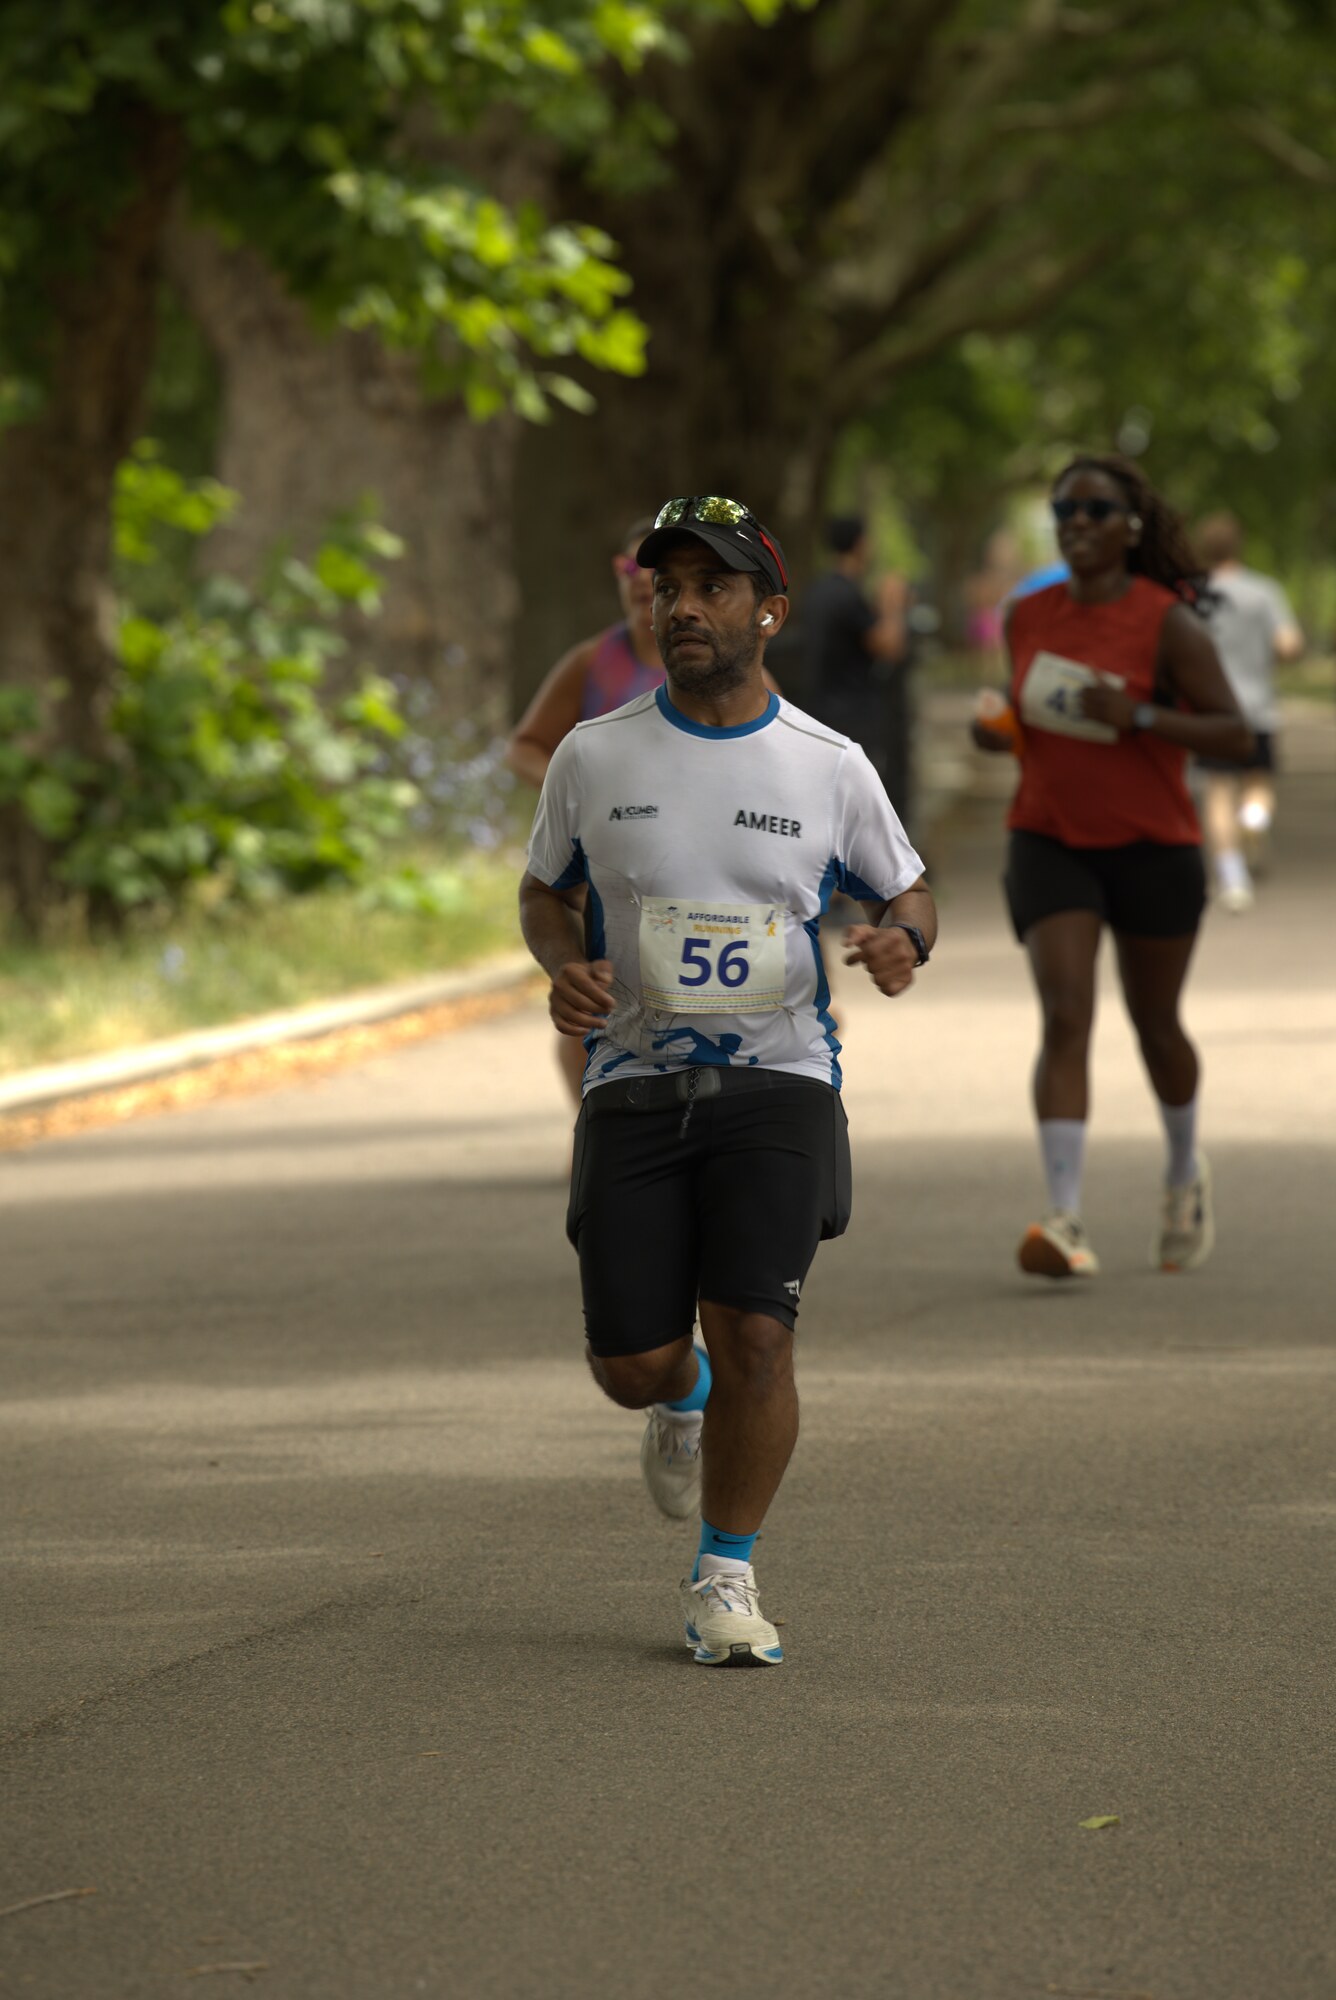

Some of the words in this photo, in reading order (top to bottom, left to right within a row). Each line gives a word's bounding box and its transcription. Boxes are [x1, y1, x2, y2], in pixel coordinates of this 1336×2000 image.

[733, 809, 802, 839] AMEER
[687, 912, 750, 924] AFFORDABLE
[693, 923, 743, 935] RUNNING
[678, 937, 750, 988] 56
